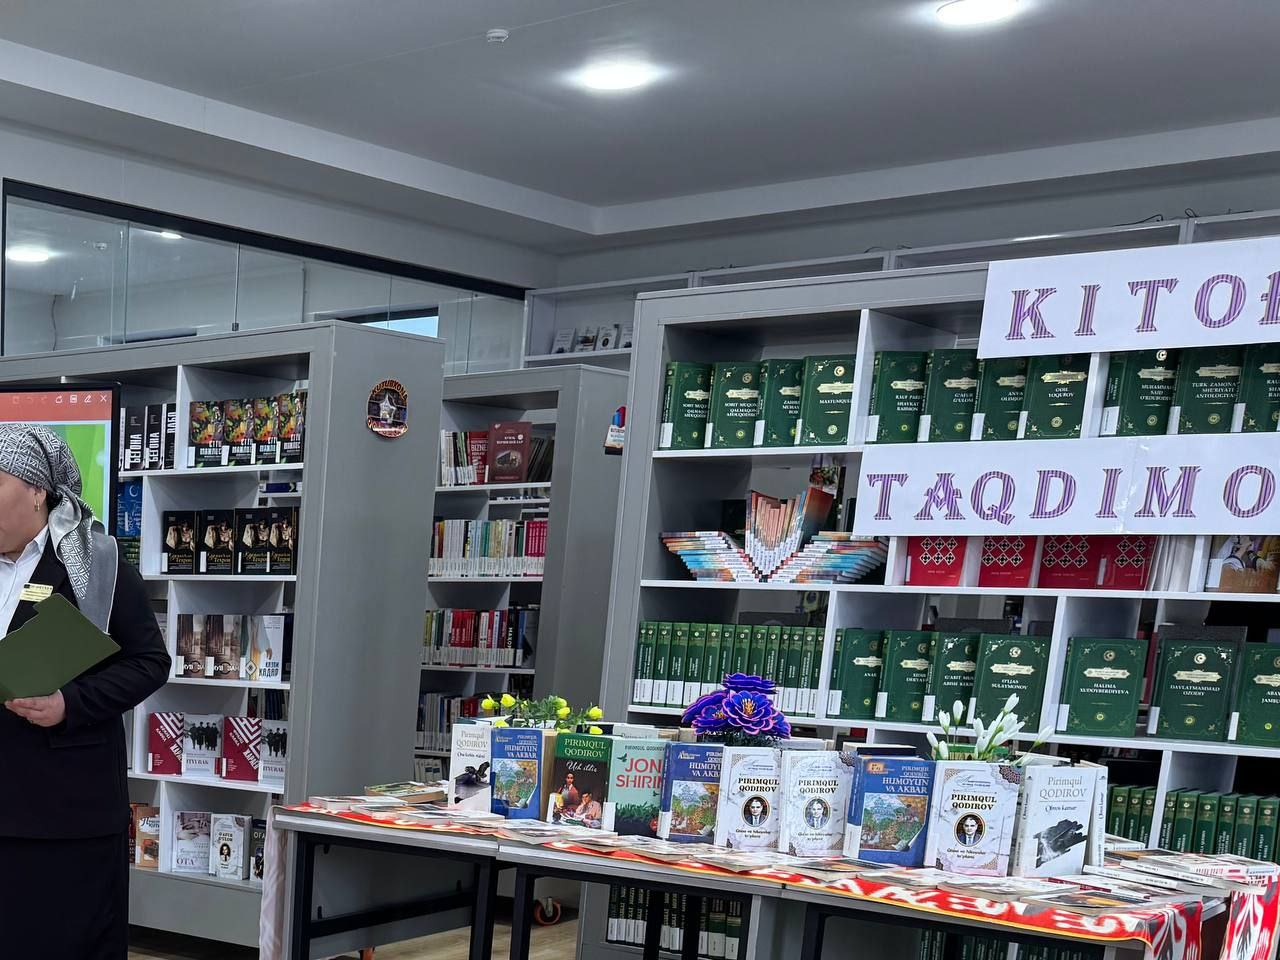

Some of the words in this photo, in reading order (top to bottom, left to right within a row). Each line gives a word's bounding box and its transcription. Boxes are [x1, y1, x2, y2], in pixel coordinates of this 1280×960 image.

[564, 738, 606, 750] PIRIMQUL
[564, 748, 604, 758] QODIROV
[625, 758, 662, 773] JON
[738, 778, 780, 786] PIRIMQUL
[882, 777, 929, 787] HUMOYUN
[1048, 776, 1083, 787] Pirimqul
[739, 785, 777, 793] QODIROV
[886, 785, 896, 793] VA
[897, 786, 928, 794] AKBAR
[1040, 788, 1088, 799] QODIROV
[951, 793, 997, 803] PIRIMQUL
[952, 802, 995, 811] QODIROV
